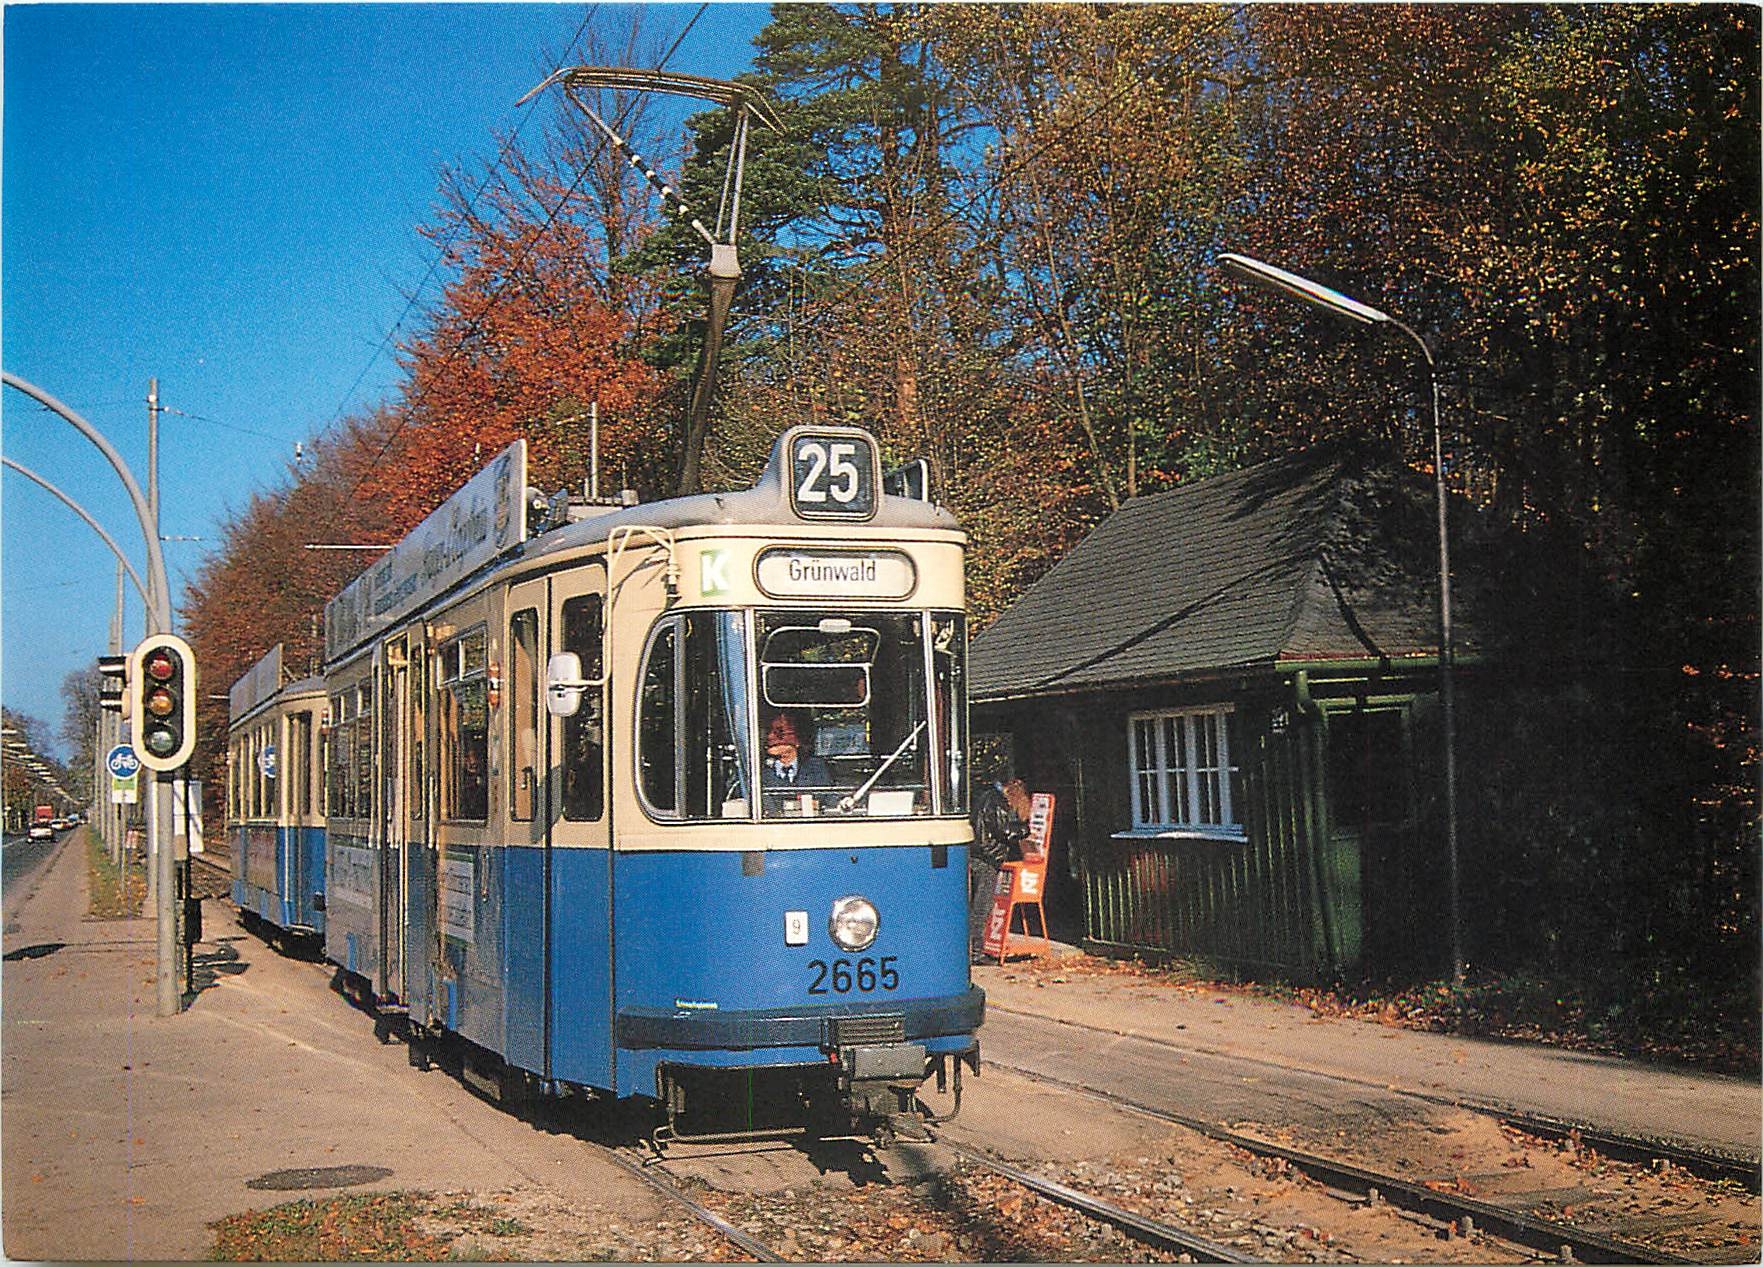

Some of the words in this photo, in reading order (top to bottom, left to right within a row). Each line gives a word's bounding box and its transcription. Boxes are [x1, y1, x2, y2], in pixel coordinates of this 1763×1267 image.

[798, 443, 858, 503] 25
[702, 553, 730, 592] K
[789, 558, 877, 582] Grünwald
[792, 919, 801, 935] 9
[808, 956, 900, 995] 2665
